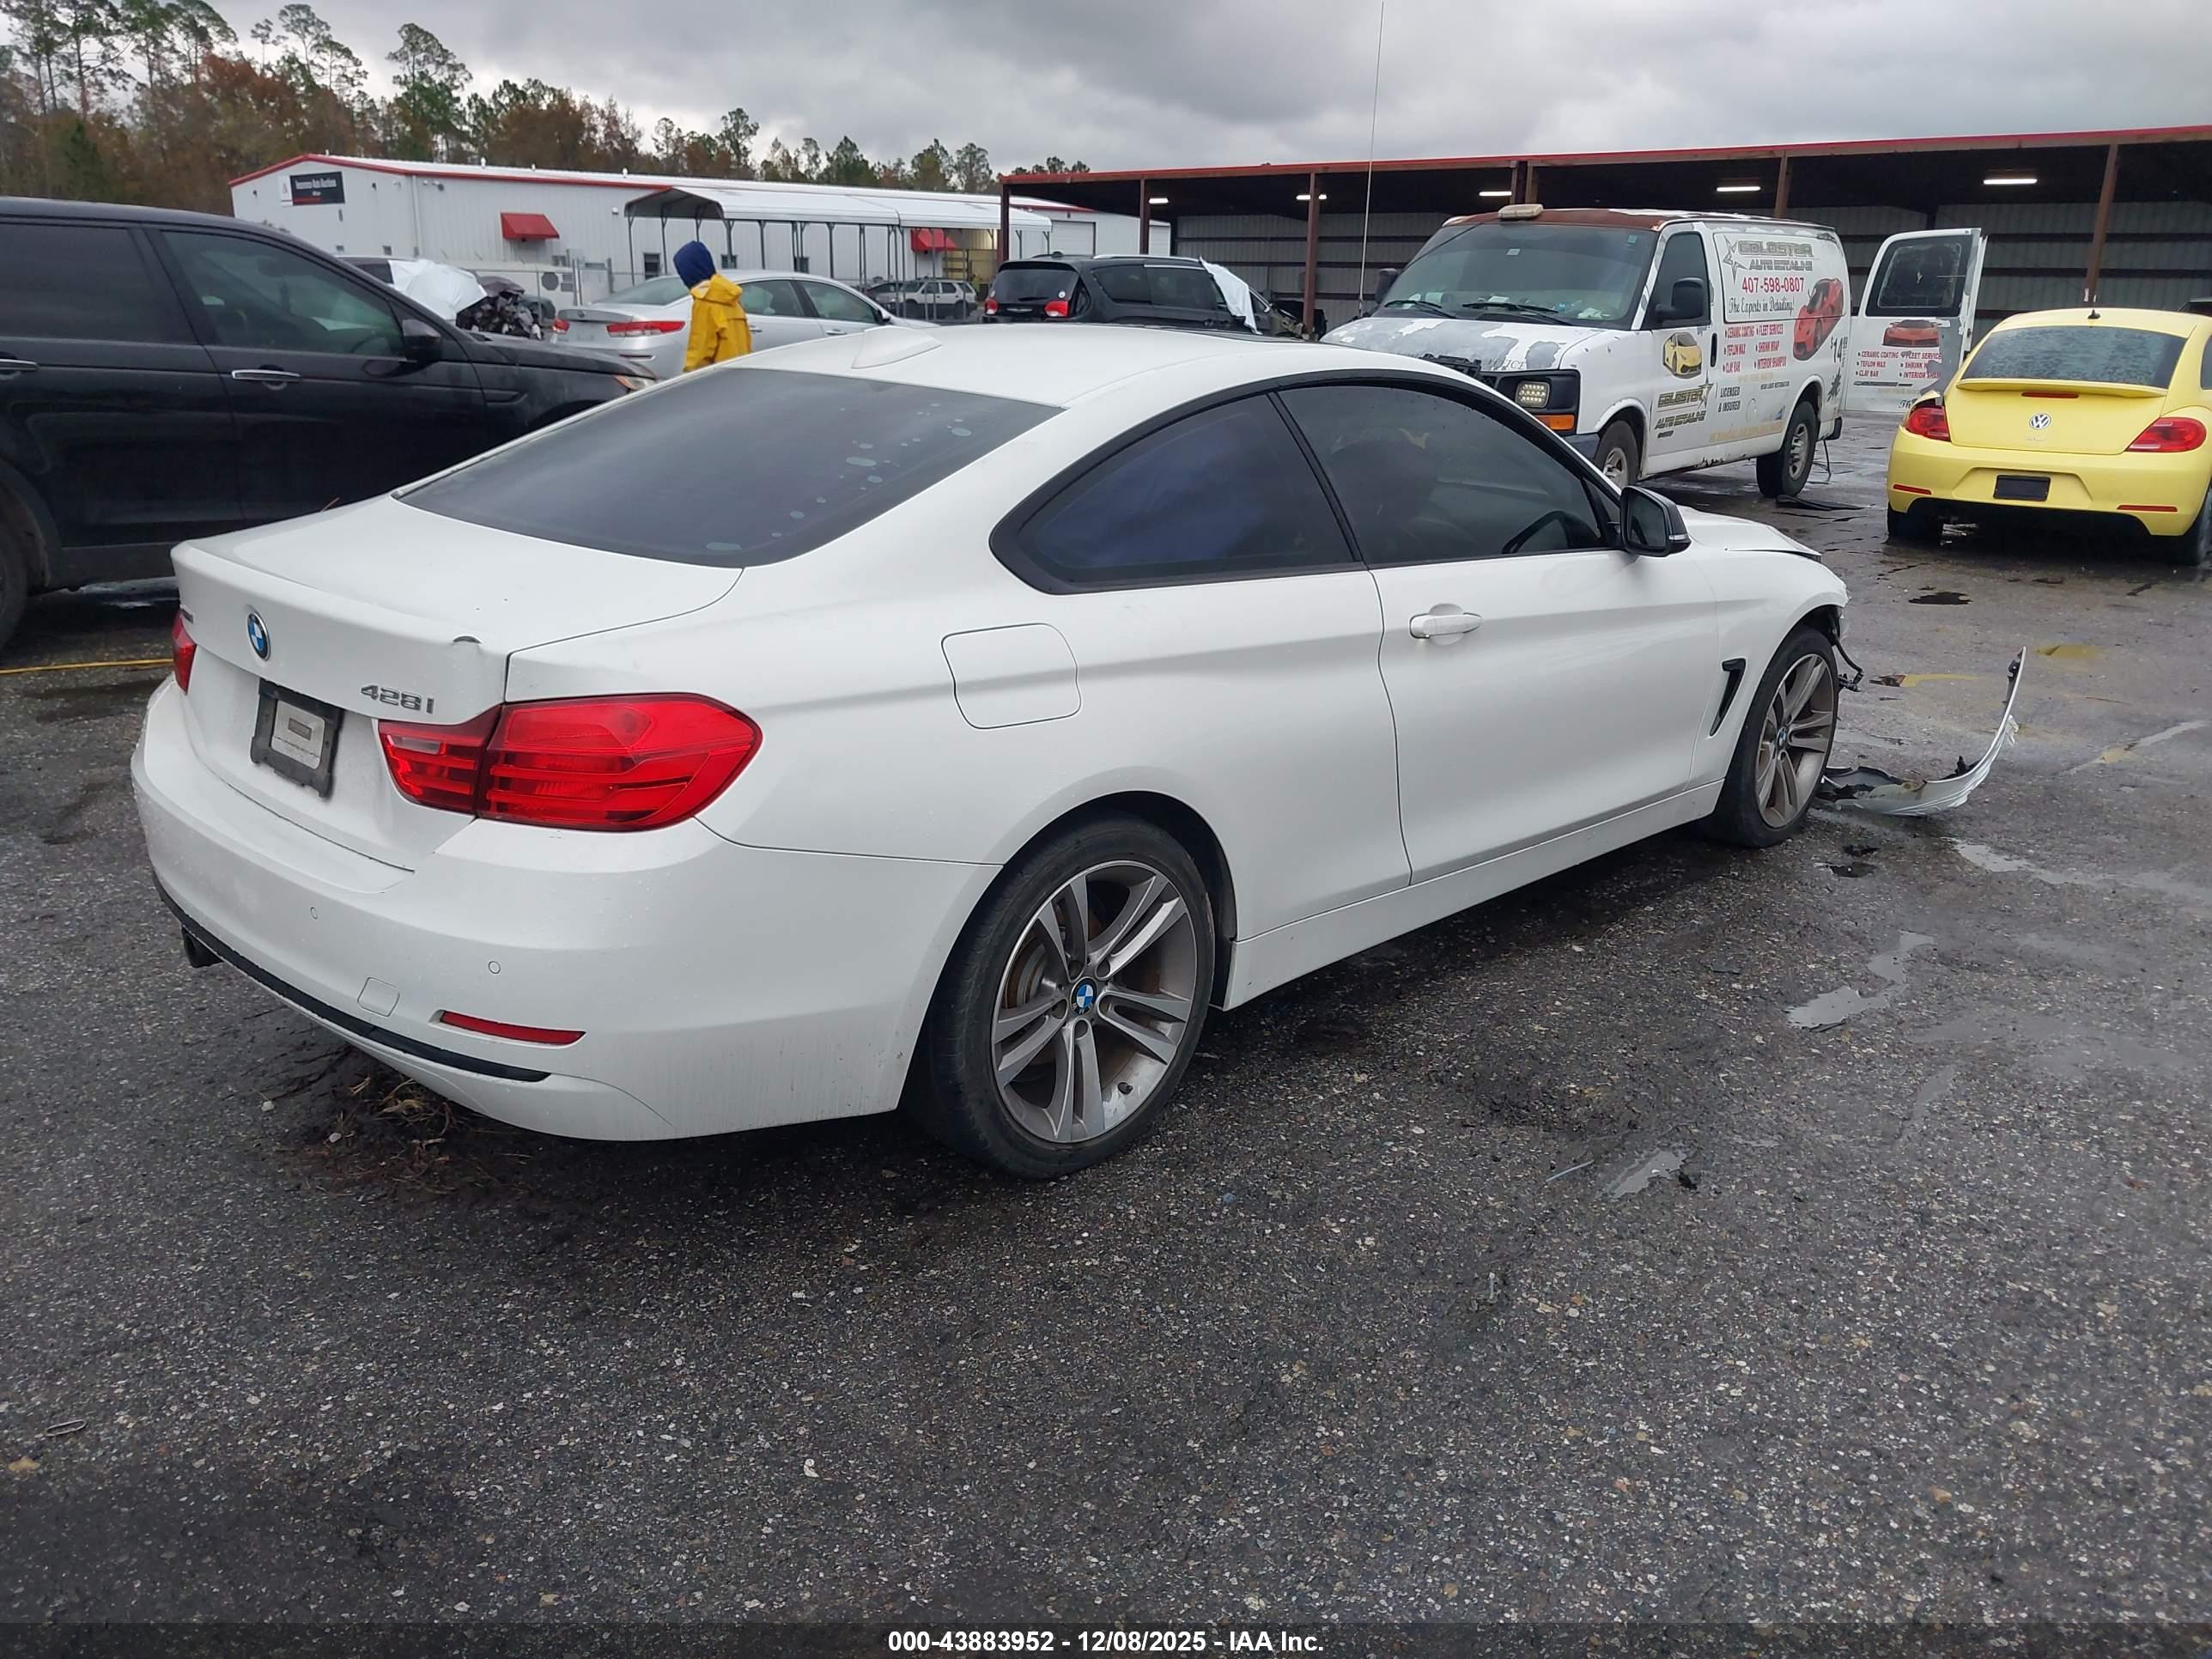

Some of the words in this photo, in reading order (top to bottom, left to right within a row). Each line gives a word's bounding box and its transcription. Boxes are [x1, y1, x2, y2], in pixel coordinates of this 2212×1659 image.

[1742, 277, 1804, 293] 407-598-0807
[1729, 297, 1739, 313] The
[1762, 299, 1768, 312] in
[1720, 386, 1741, 398] LICENSED
[1723, 400, 1741, 412] INSURED
